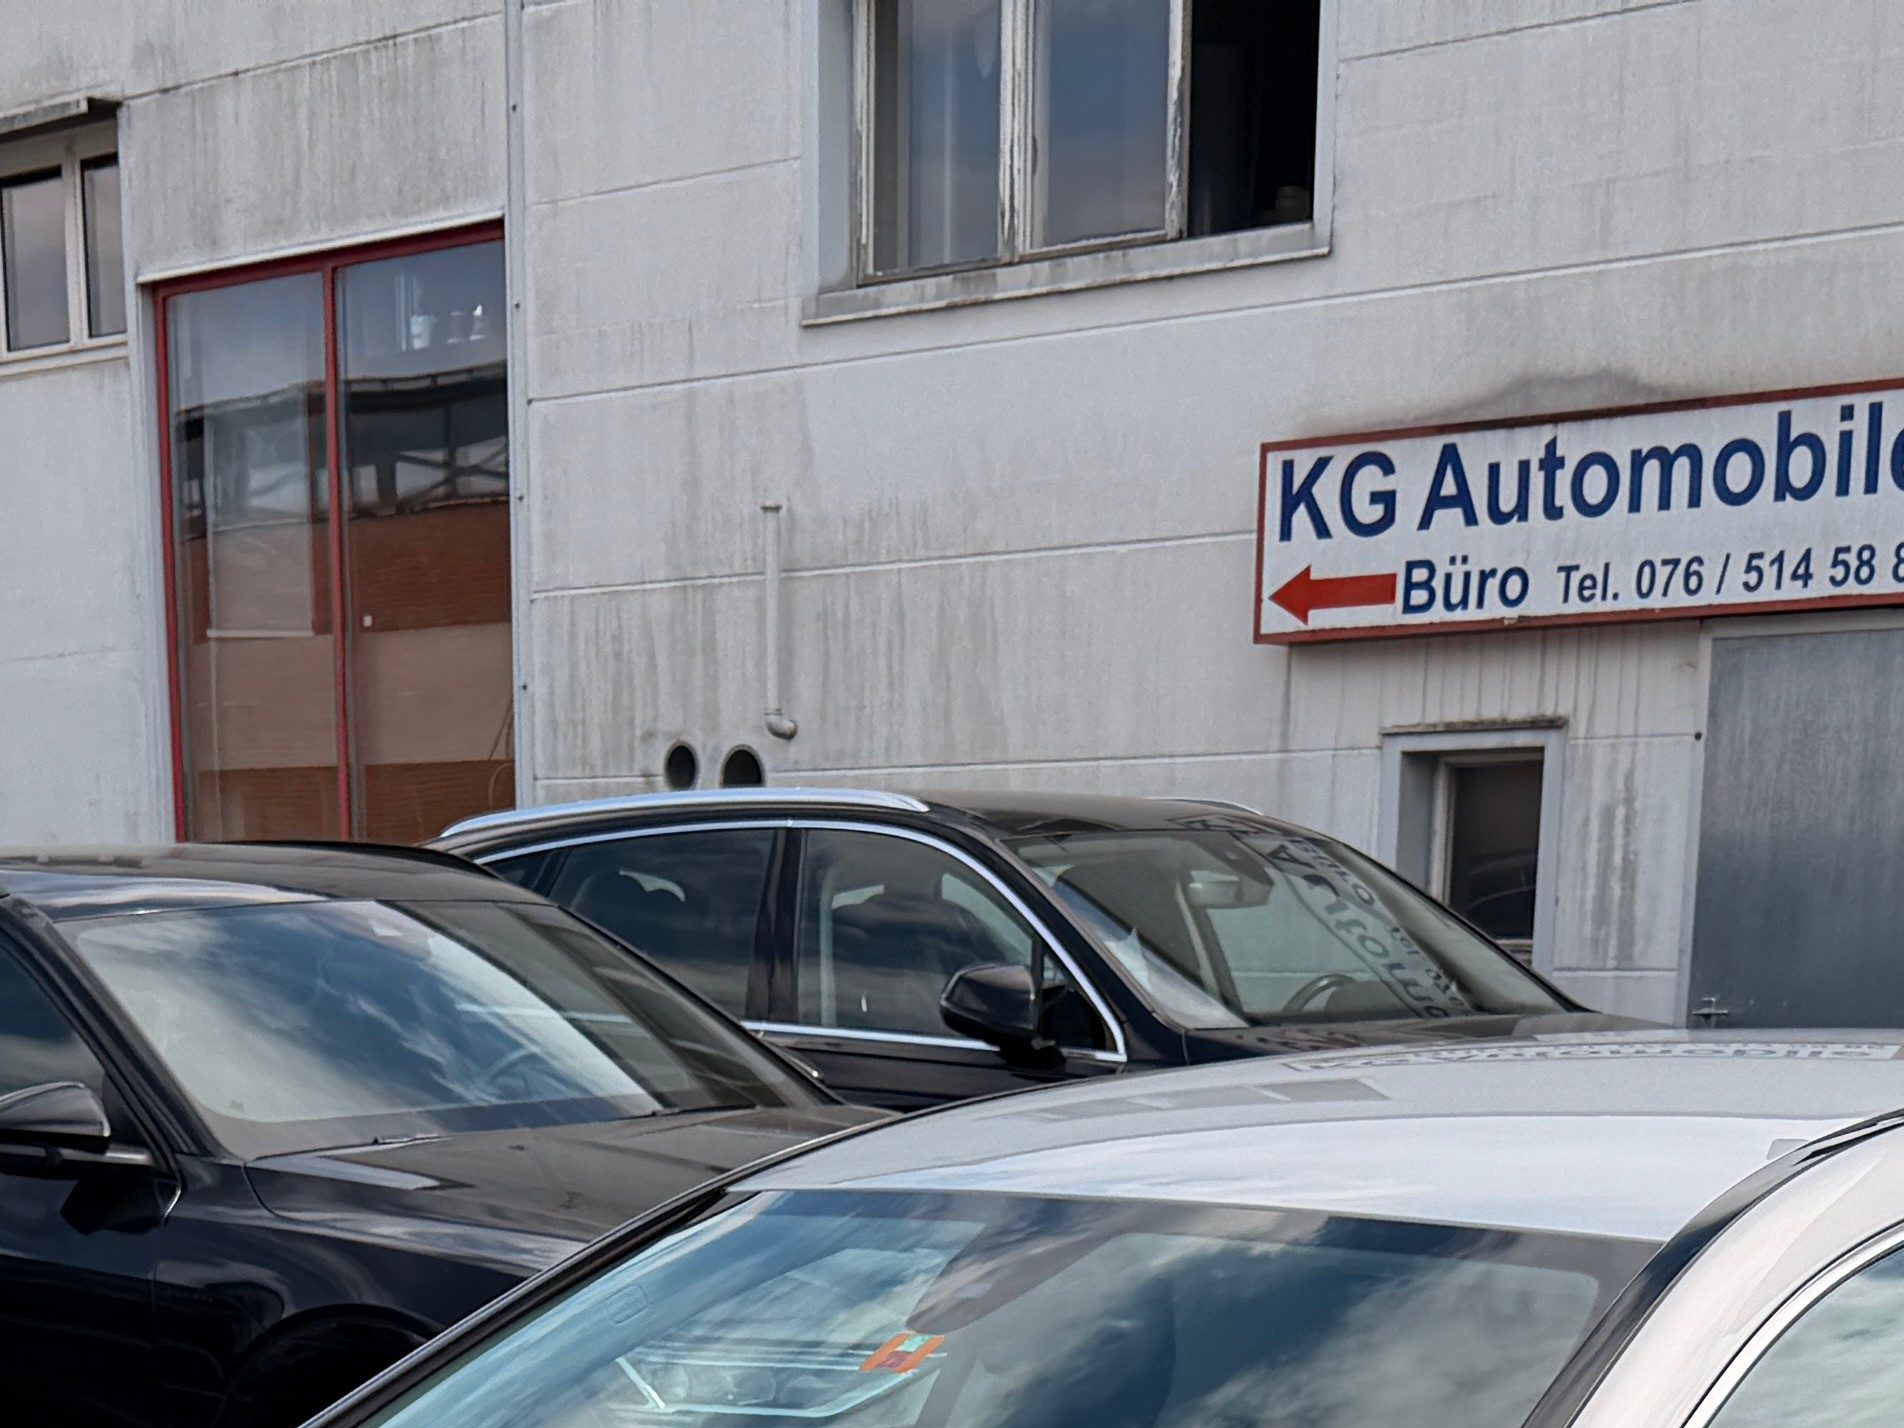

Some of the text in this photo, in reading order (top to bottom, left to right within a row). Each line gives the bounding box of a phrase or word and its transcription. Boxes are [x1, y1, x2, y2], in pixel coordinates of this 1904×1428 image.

[1277, 450, 1397, 544] KG
[1400, 557, 1530, 616] Büro
[1555, 564, 1620, 606] Tel.
[1635, 555, 1704, 599] 076
[1715, 553, 1731, 595] /
[1742, 546, 1813, 593] 514
[1828, 543, 1877, 587] 58
